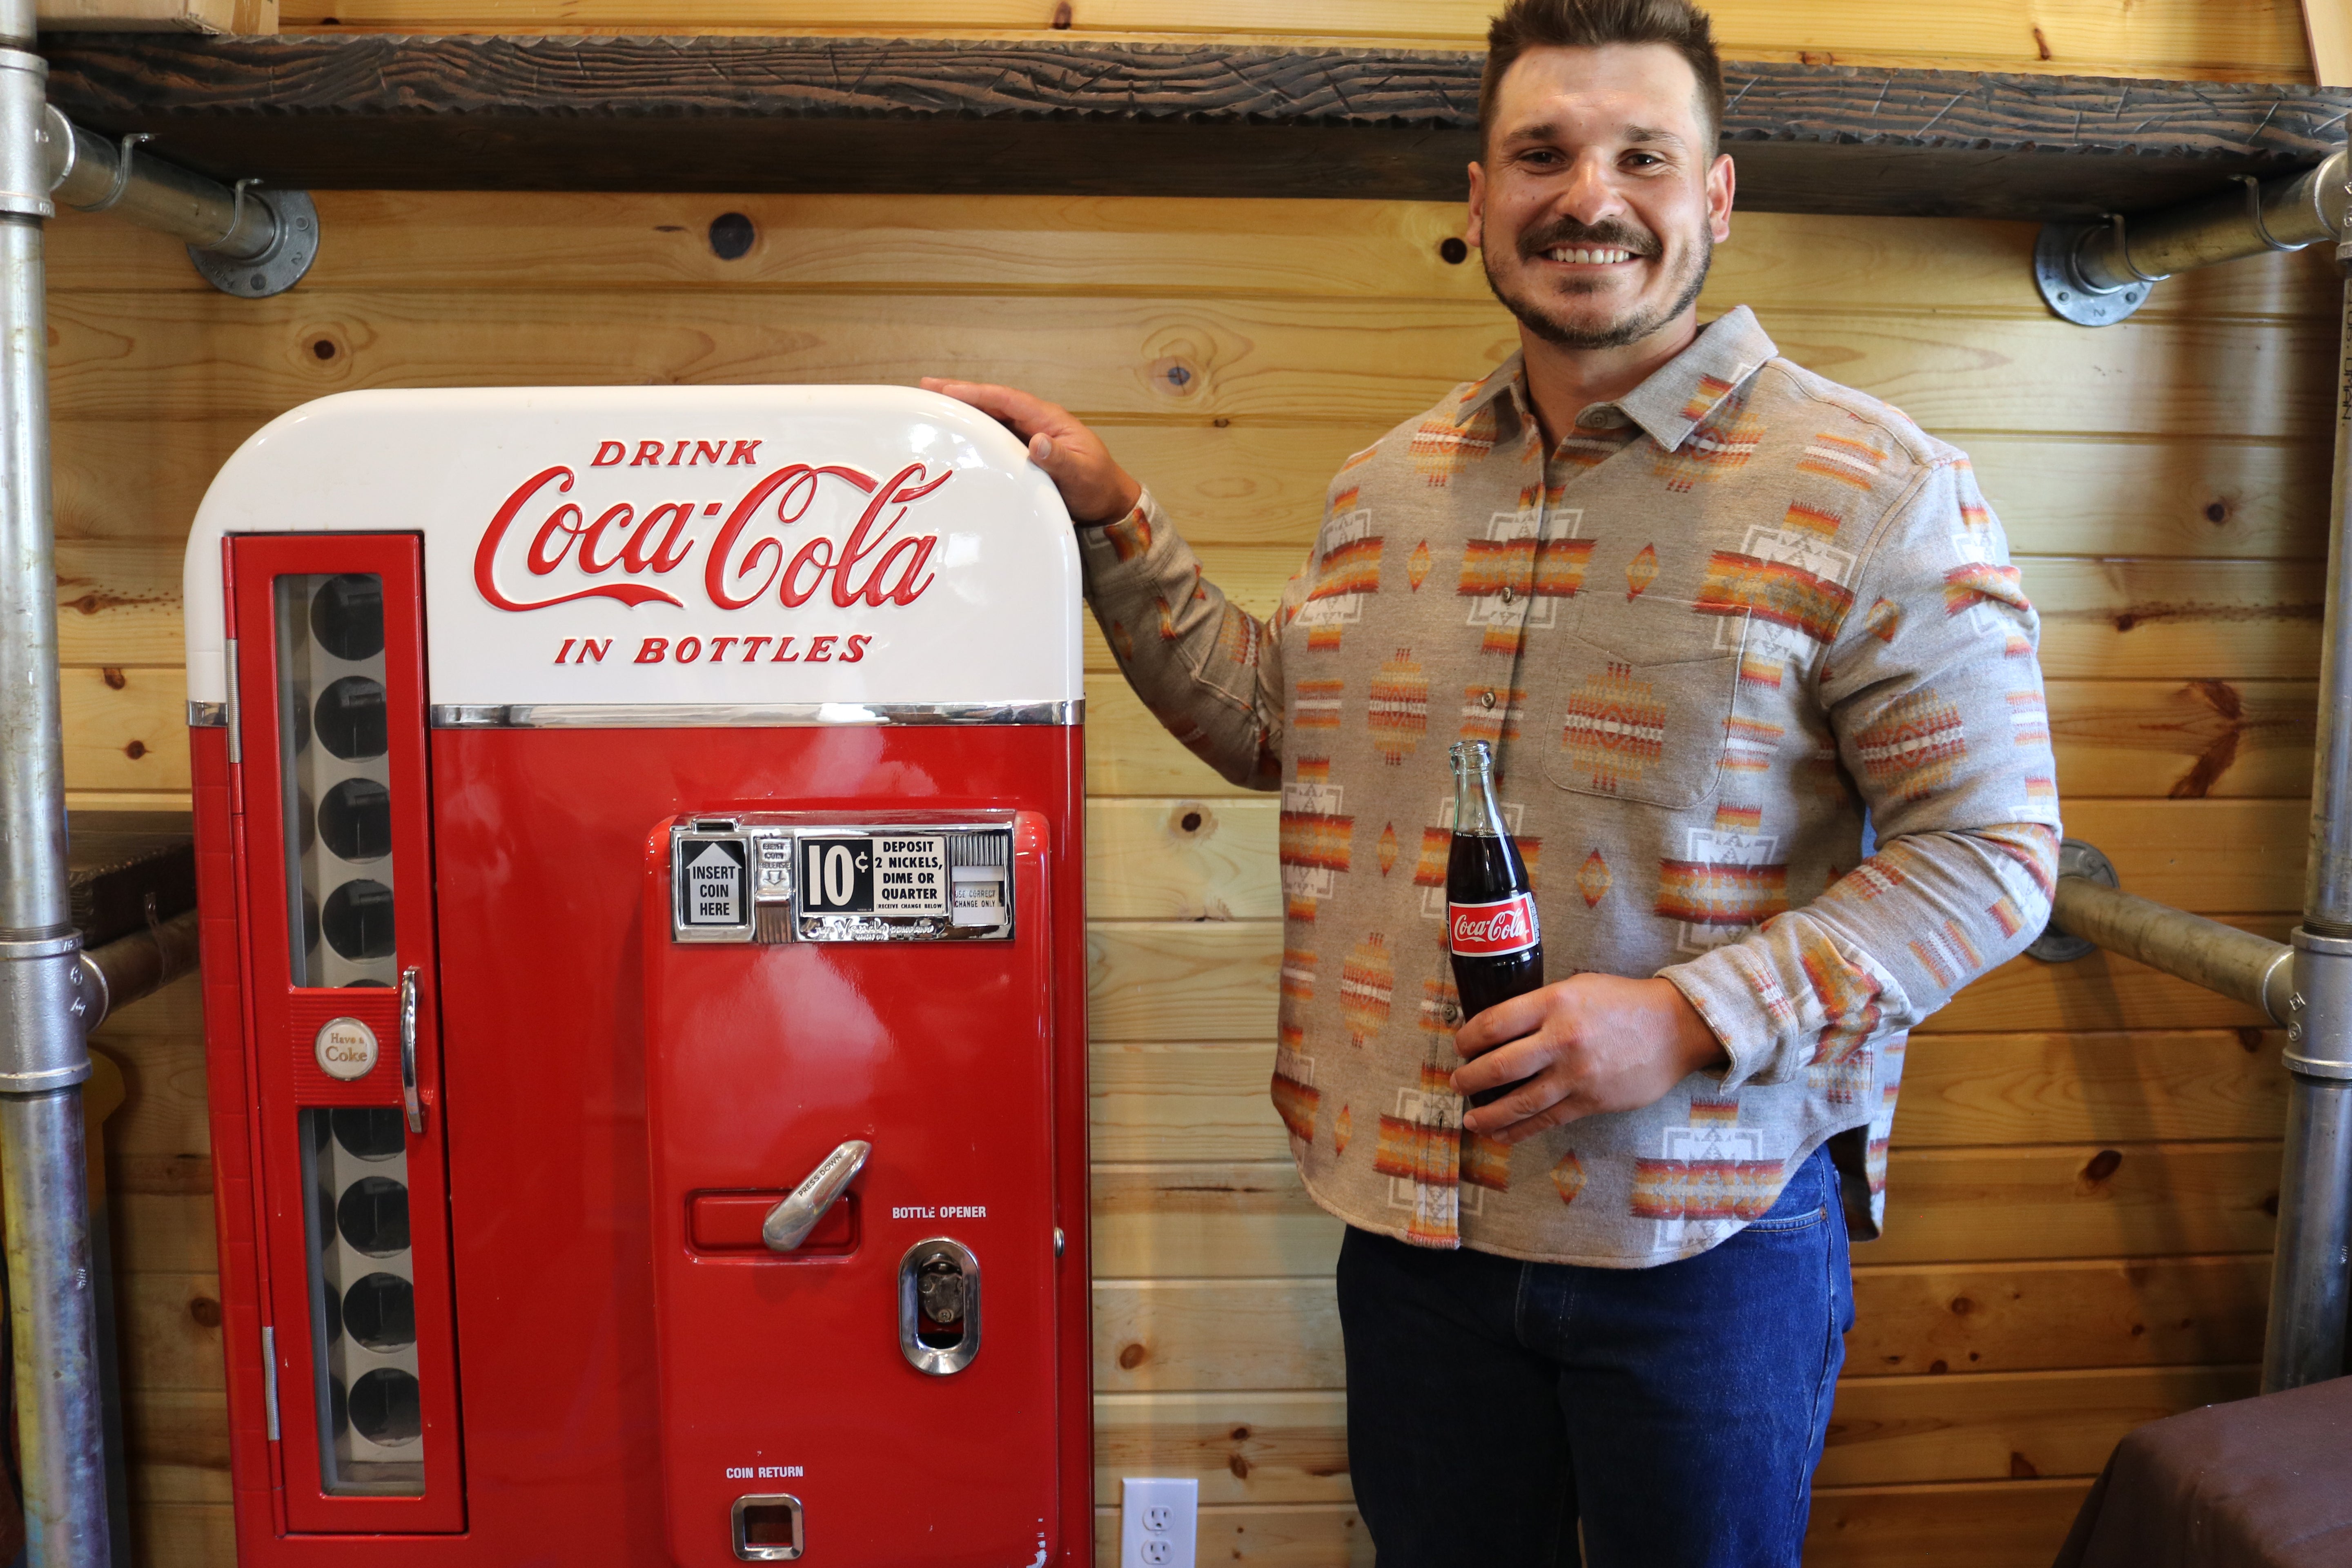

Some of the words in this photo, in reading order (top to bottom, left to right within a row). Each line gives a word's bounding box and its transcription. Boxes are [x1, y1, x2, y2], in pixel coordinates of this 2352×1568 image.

[590, 440, 762, 466] DRINK
[473, 463, 953, 612] Coca-Cola
[554, 639, 614, 664] IN
[633, 635, 873, 664] BOTTLES
[883, 842, 934, 852] DEPOSIT
[875, 857, 882, 868] 2
[889, 857, 943, 870] NICKELS,
[693, 866, 735, 879] INSERT
[883, 873, 913, 884] DIME
[918, 873, 934, 883] OR
[700, 884, 728, 897] COIN
[882, 889, 938, 900] QUARTER
[700, 902, 730, 915] HERE
[1454, 907, 1524, 942] Coca-Cola
[330, 1033, 356, 1044] Have
[325, 1046, 368, 1062] Coke
[798, 1175, 820, 1196] PRESS
[820, 1154, 842, 1176] DOWN
[893, 1207, 935, 1218] BOTTLE
[940, 1206, 986, 1218] OPENER
[726, 1468, 753, 1479] COIN
[758, 1466, 803, 1478] RETURN
